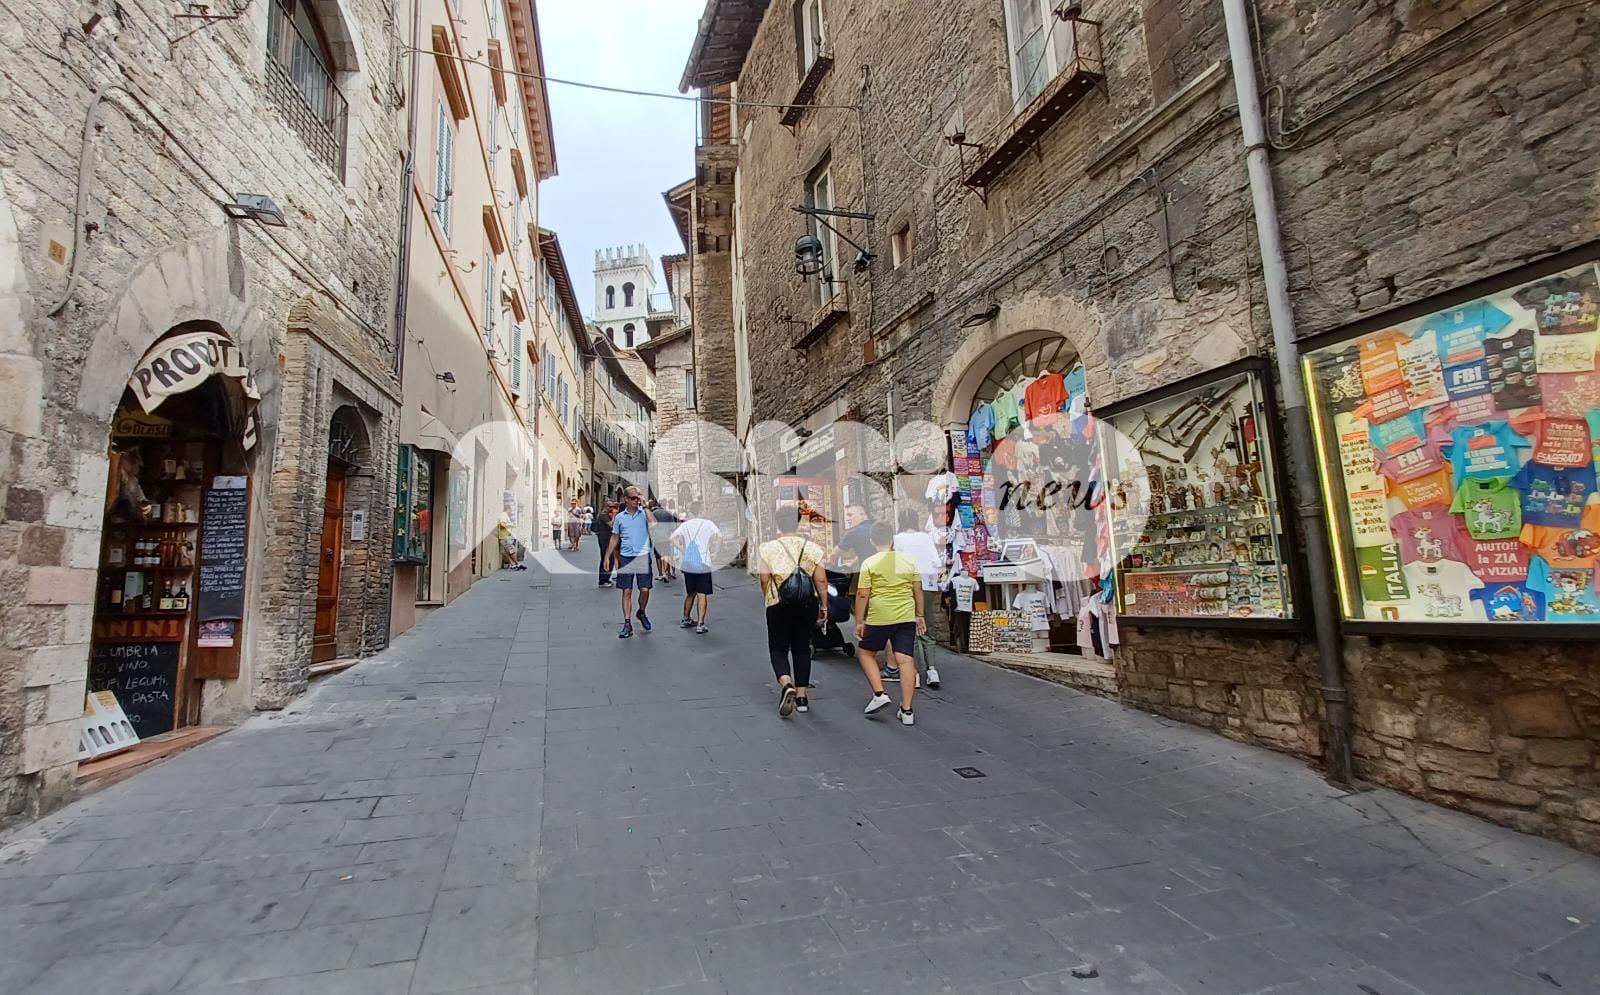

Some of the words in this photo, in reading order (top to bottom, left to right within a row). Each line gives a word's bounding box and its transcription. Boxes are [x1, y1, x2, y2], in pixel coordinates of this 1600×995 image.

[1453, 365, 1482, 386] FBI
[1397, 447, 1425, 468] FBI
[1475, 542, 1519, 552] AIUTO!!
[1478, 554, 1489, 564] la
[1494, 553, 1518, 563] ZIA
[1381, 543, 1407, 599] ITALIA
[1487, 567, 1528, 576] VIZIA!!
[110, 645, 159, 657] UMBRIA
[132, 690, 170, 704] PASTA
